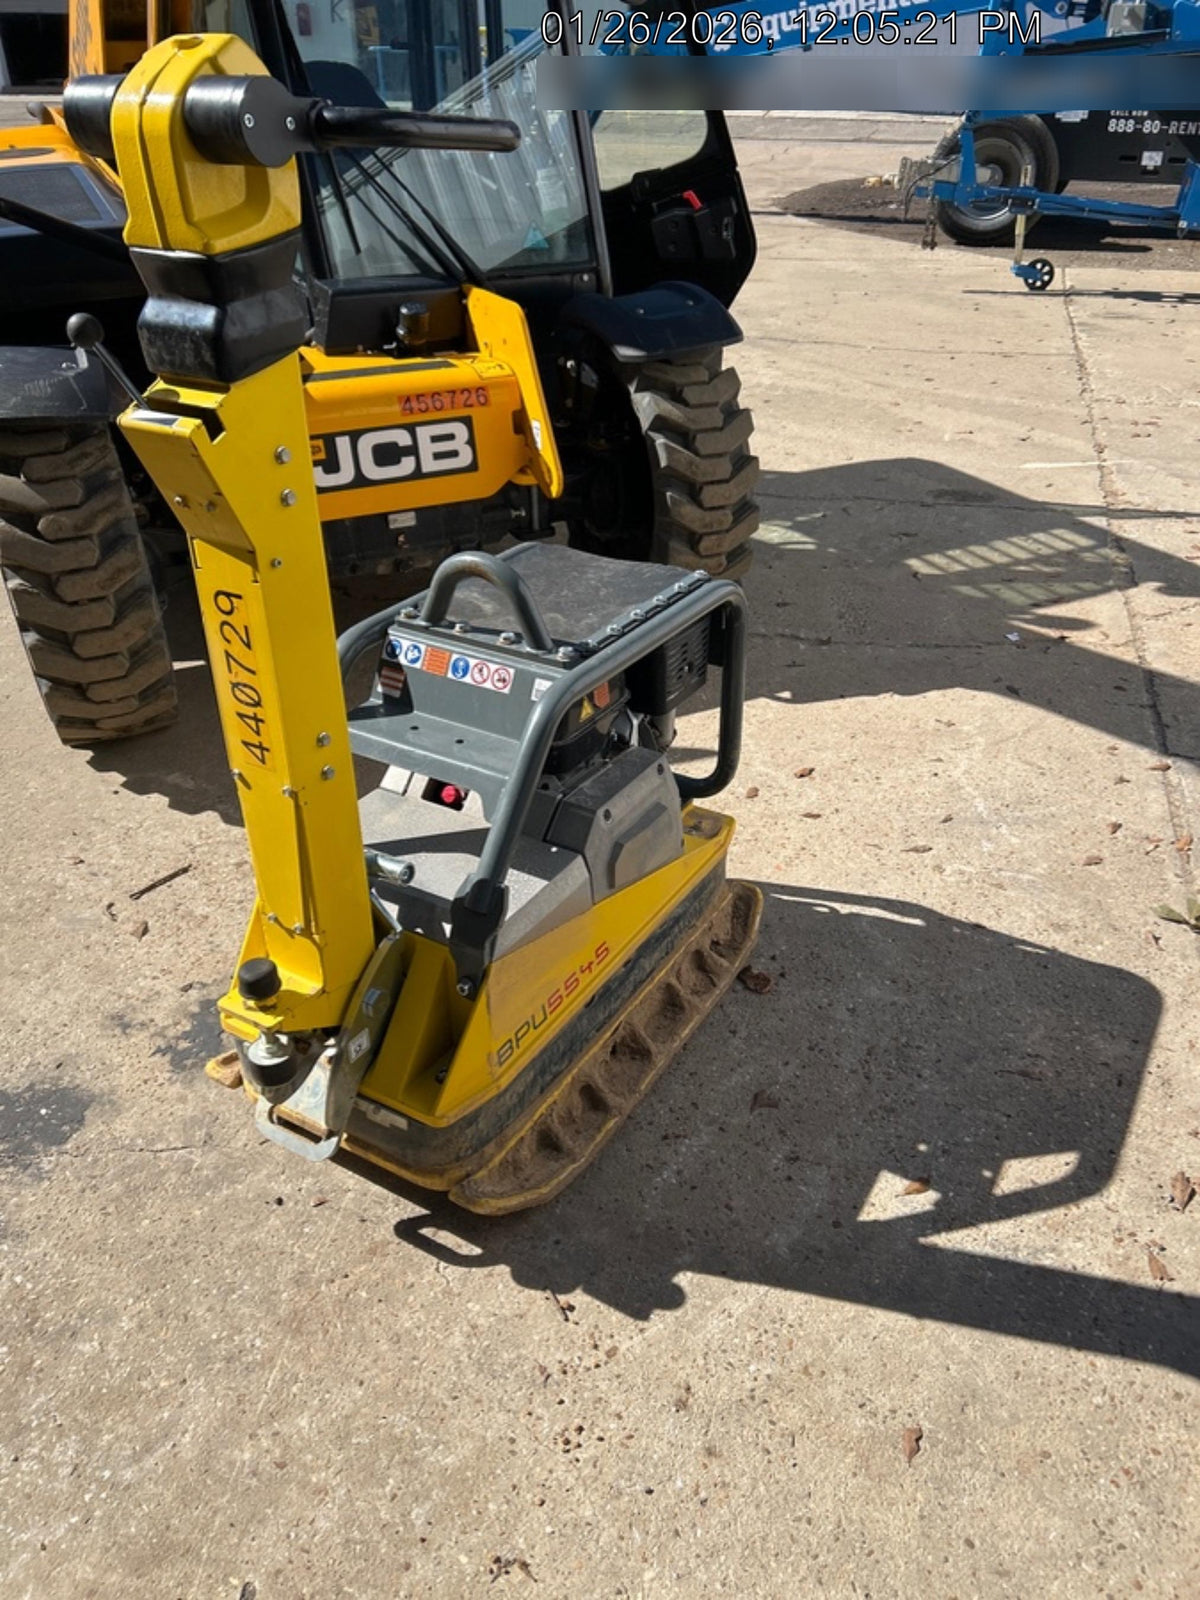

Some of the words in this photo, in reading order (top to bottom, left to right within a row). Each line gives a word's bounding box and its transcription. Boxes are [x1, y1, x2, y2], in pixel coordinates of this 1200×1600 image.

[401, 386, 489, 415] 456726
[314, 421, 474, 488] JCB
[213, 589, 271, 766] 440729
